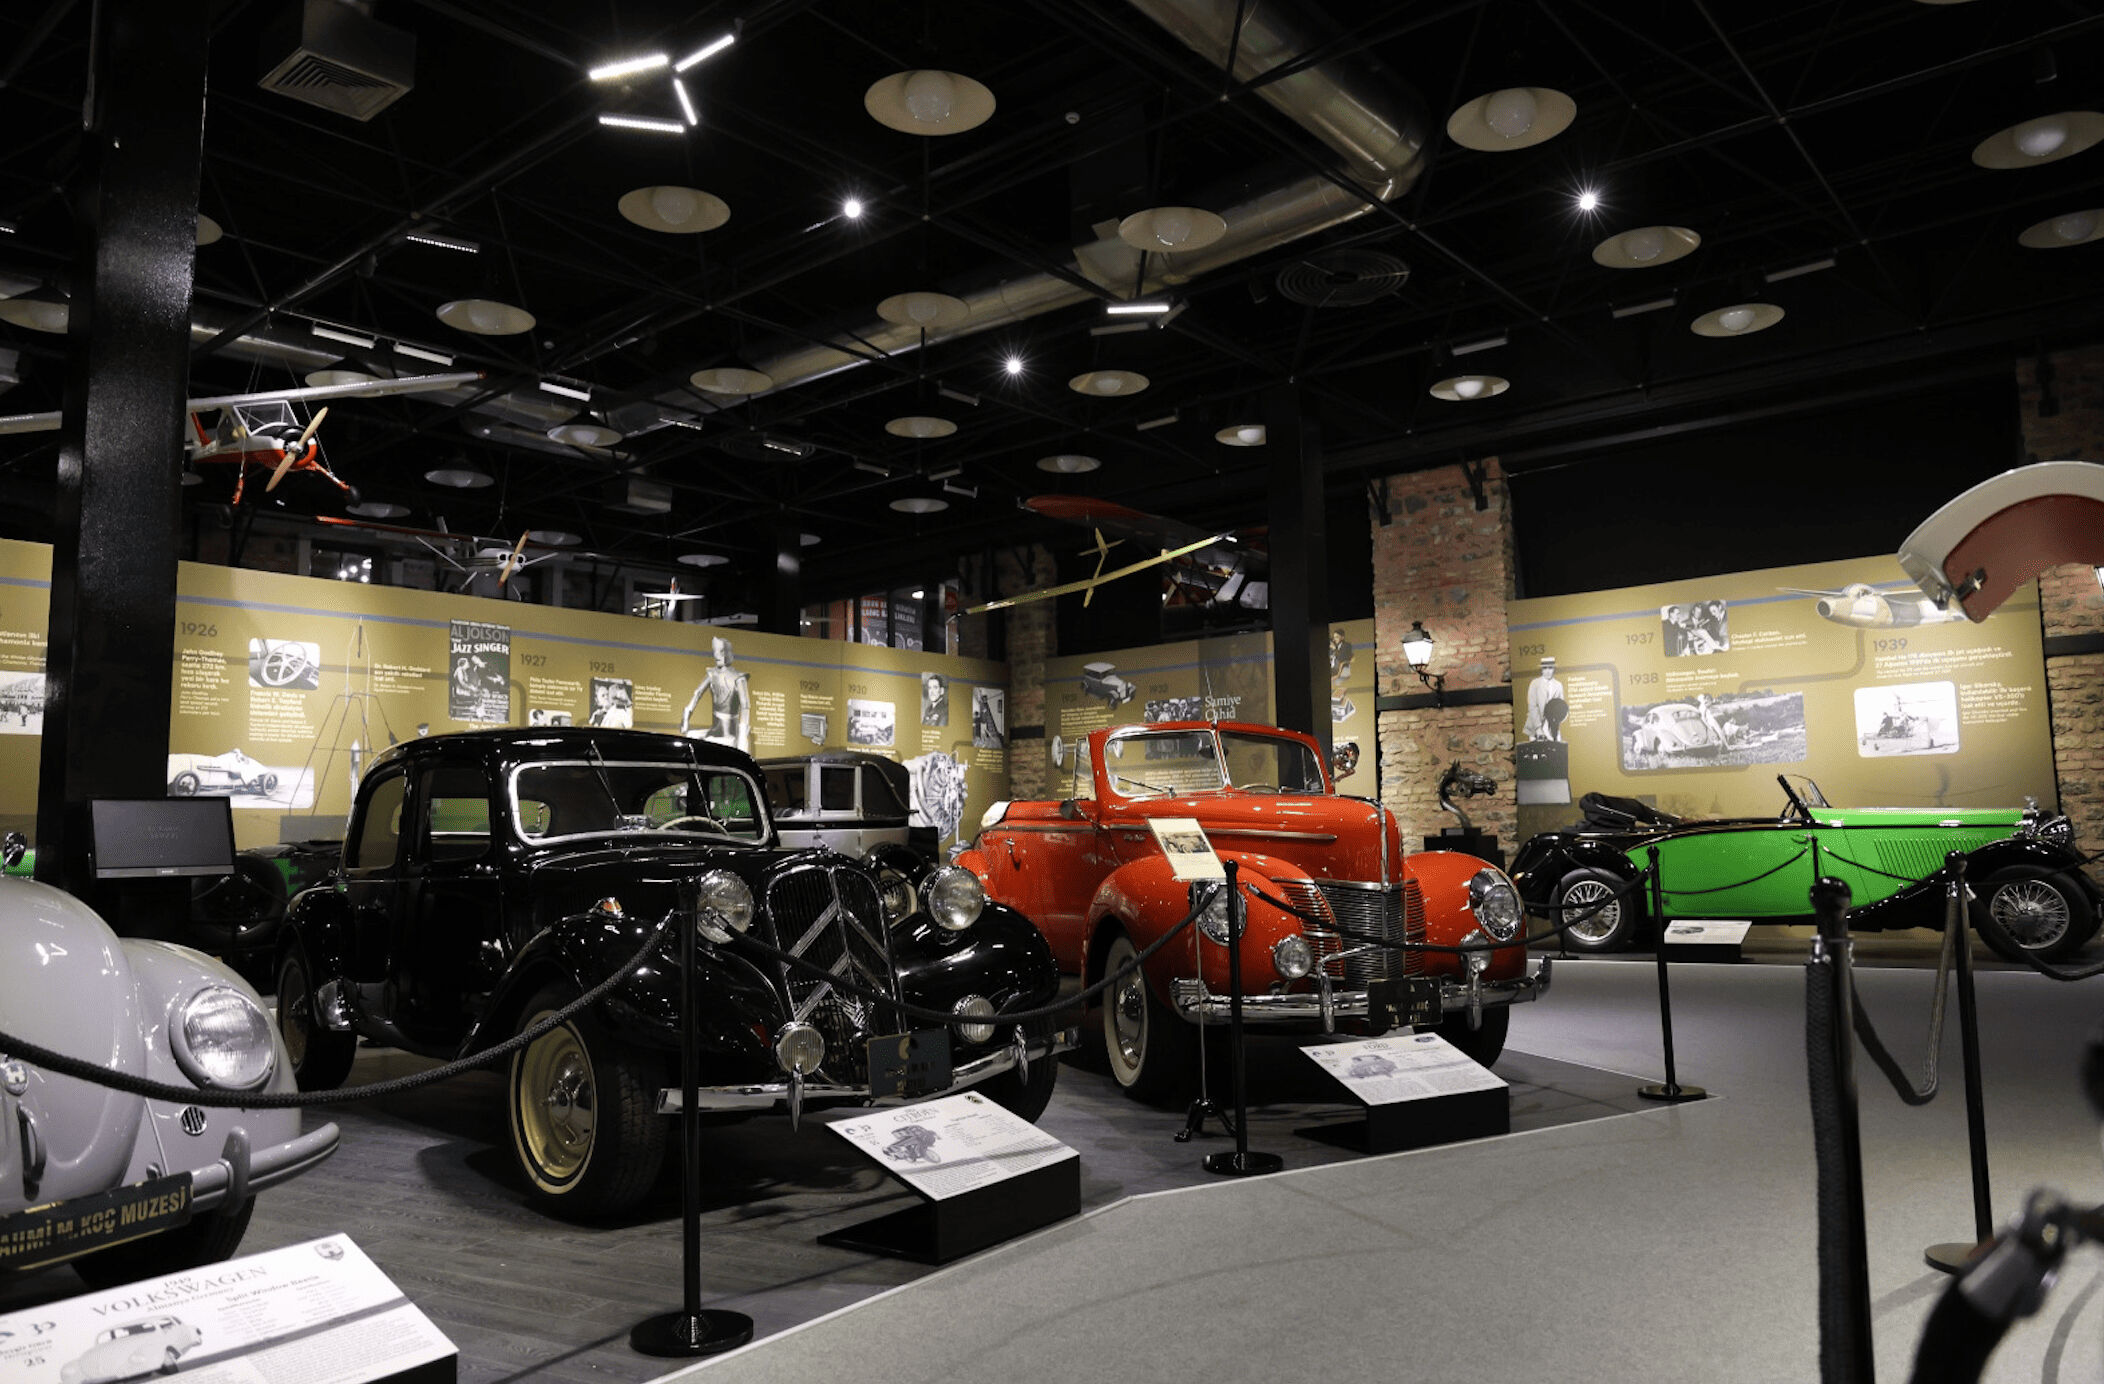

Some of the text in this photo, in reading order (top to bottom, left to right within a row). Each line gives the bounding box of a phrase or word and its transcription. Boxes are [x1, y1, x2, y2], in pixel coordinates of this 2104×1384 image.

[181, 622, 218, 637] 1926
[451, 624, 463, 639] AL
[464, 626, 509, 642] JOLSON
[1626, 632, 1655, 645] 1937
[1873, 638, 1907, 651] 1939
[451, 642, 509, 655] JAZZ SINGER
[1518, 644, 1545, 656] 1933
[521, 654, 547, 667] 1927
[590, 662, 615, 673] 1928
[1630, 673, 1659, 685] 1938
[1205, 695, 1241, 708] Samiye
[81, 1207, 117, 1236] KOÇ
[92, 1266, 268, 1316] VOLKSWAGEN
